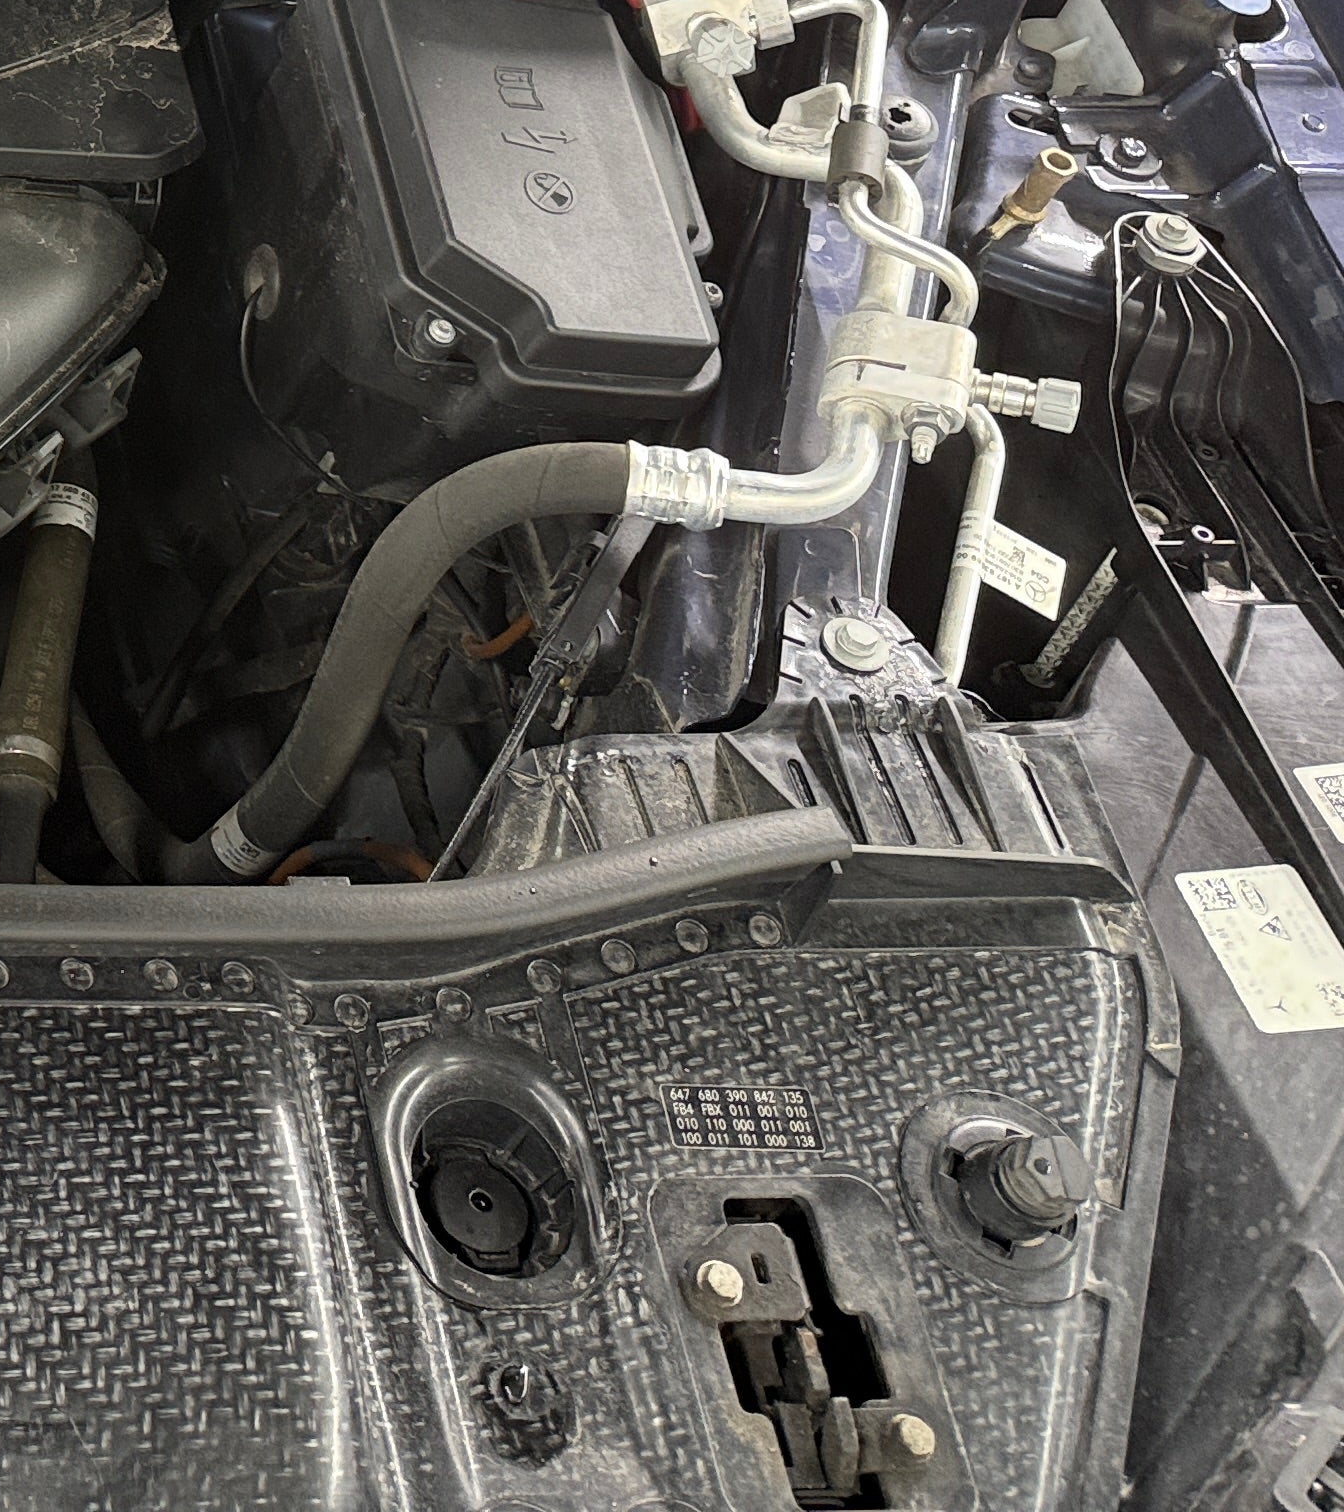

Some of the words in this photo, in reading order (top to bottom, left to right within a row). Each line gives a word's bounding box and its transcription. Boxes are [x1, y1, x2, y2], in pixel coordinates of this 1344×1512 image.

[670, 1088, 690, 1101] 647
[698, 1090, 719, 1102] 680
[725, 1090, 747, 1102] 390
[754, 1091, 775, 1103] 842
[783, 1091, 803, 1103] 135
[729, 1104, 750, 1117] 011
[757, 1105, 778, 1118] 001
[785, 1106, 808, 1118] 010
[676, 1118, 698, 1130] 010
[706, 1118, 726, 1130] 110
[733, 1119, 755, 1131] 000
[761, 1119, 781, 1132] 011
[789, 1120, 811, 1132] 001
[682, 1132, 701, 1144] 100
[708, 1133, 729, 1145] 011
[738, 1134, 757, 1146] 101
[765, 1135, 787, 1147] 000
[795, 1135, 815, 1147] 138
